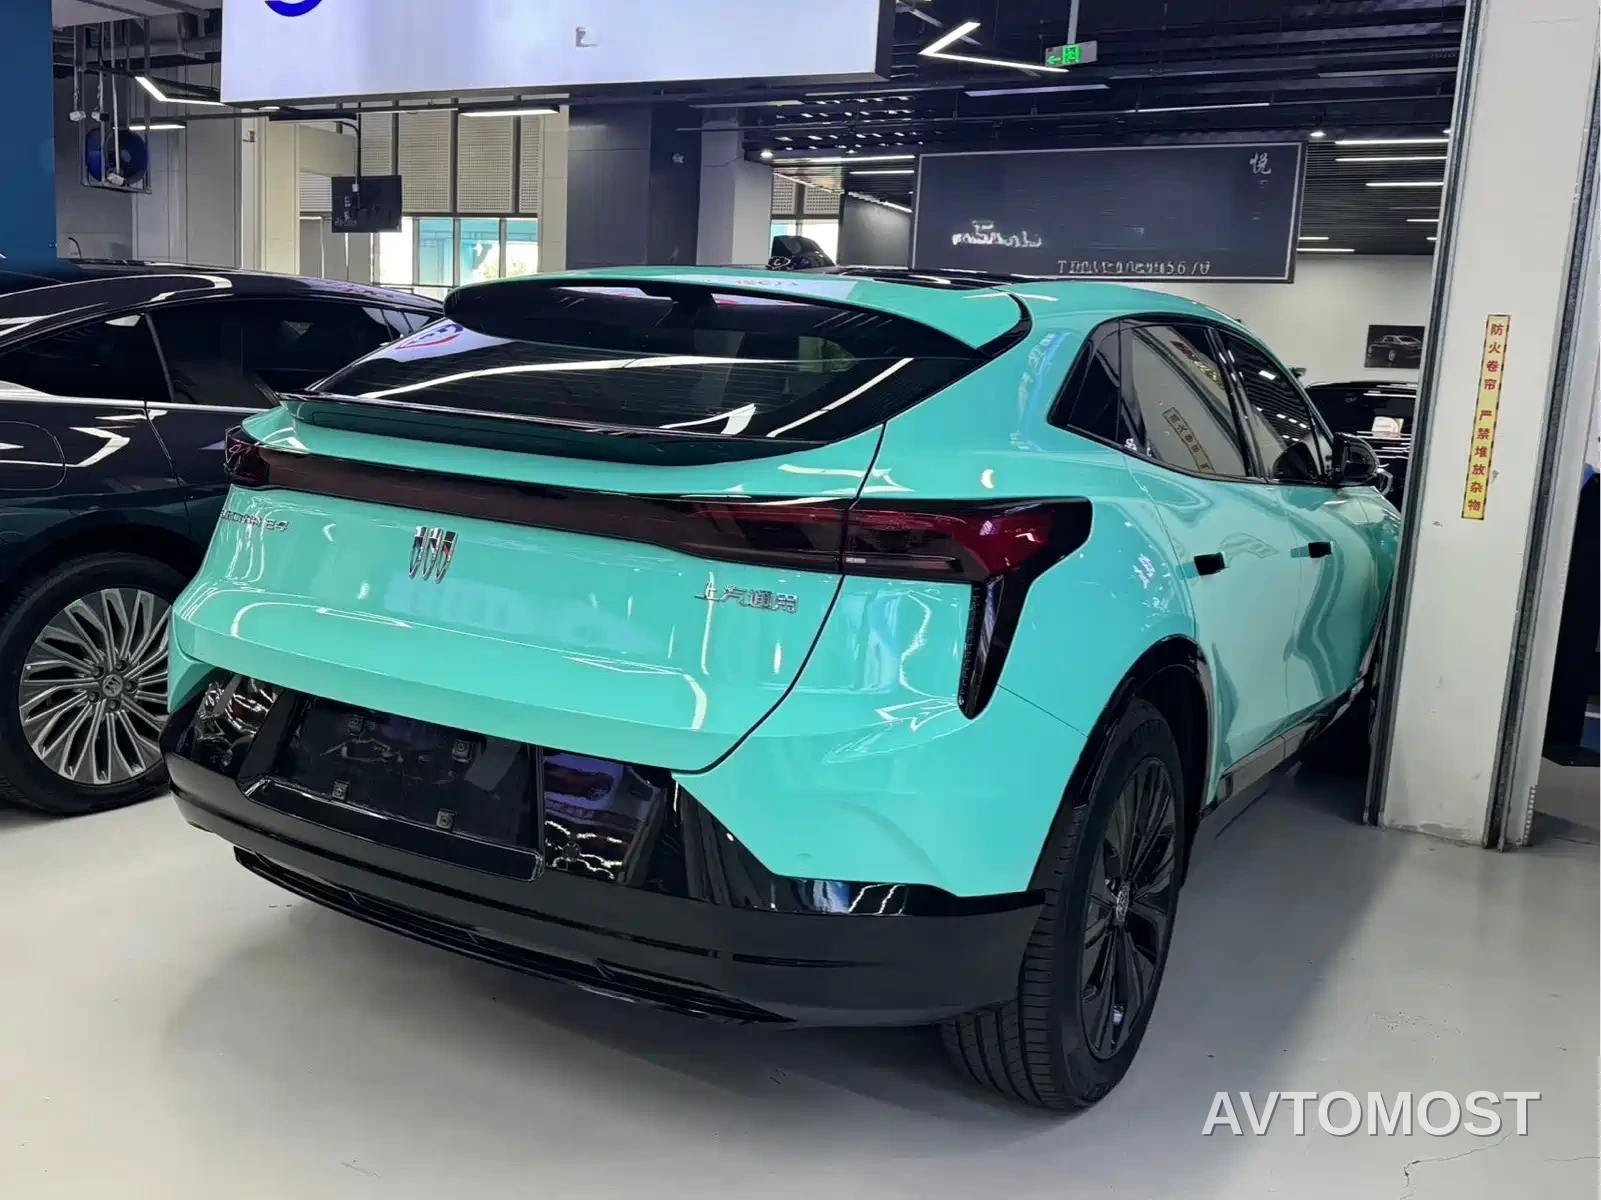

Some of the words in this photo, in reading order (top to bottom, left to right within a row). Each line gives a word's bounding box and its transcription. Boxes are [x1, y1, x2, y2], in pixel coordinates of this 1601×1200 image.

[1483, 323, 1505, 390] 防火卷帘
[1467, 409, 1493, 512] 严禁堆放杂物
[694, 582, 799, 613] 上汽通用
